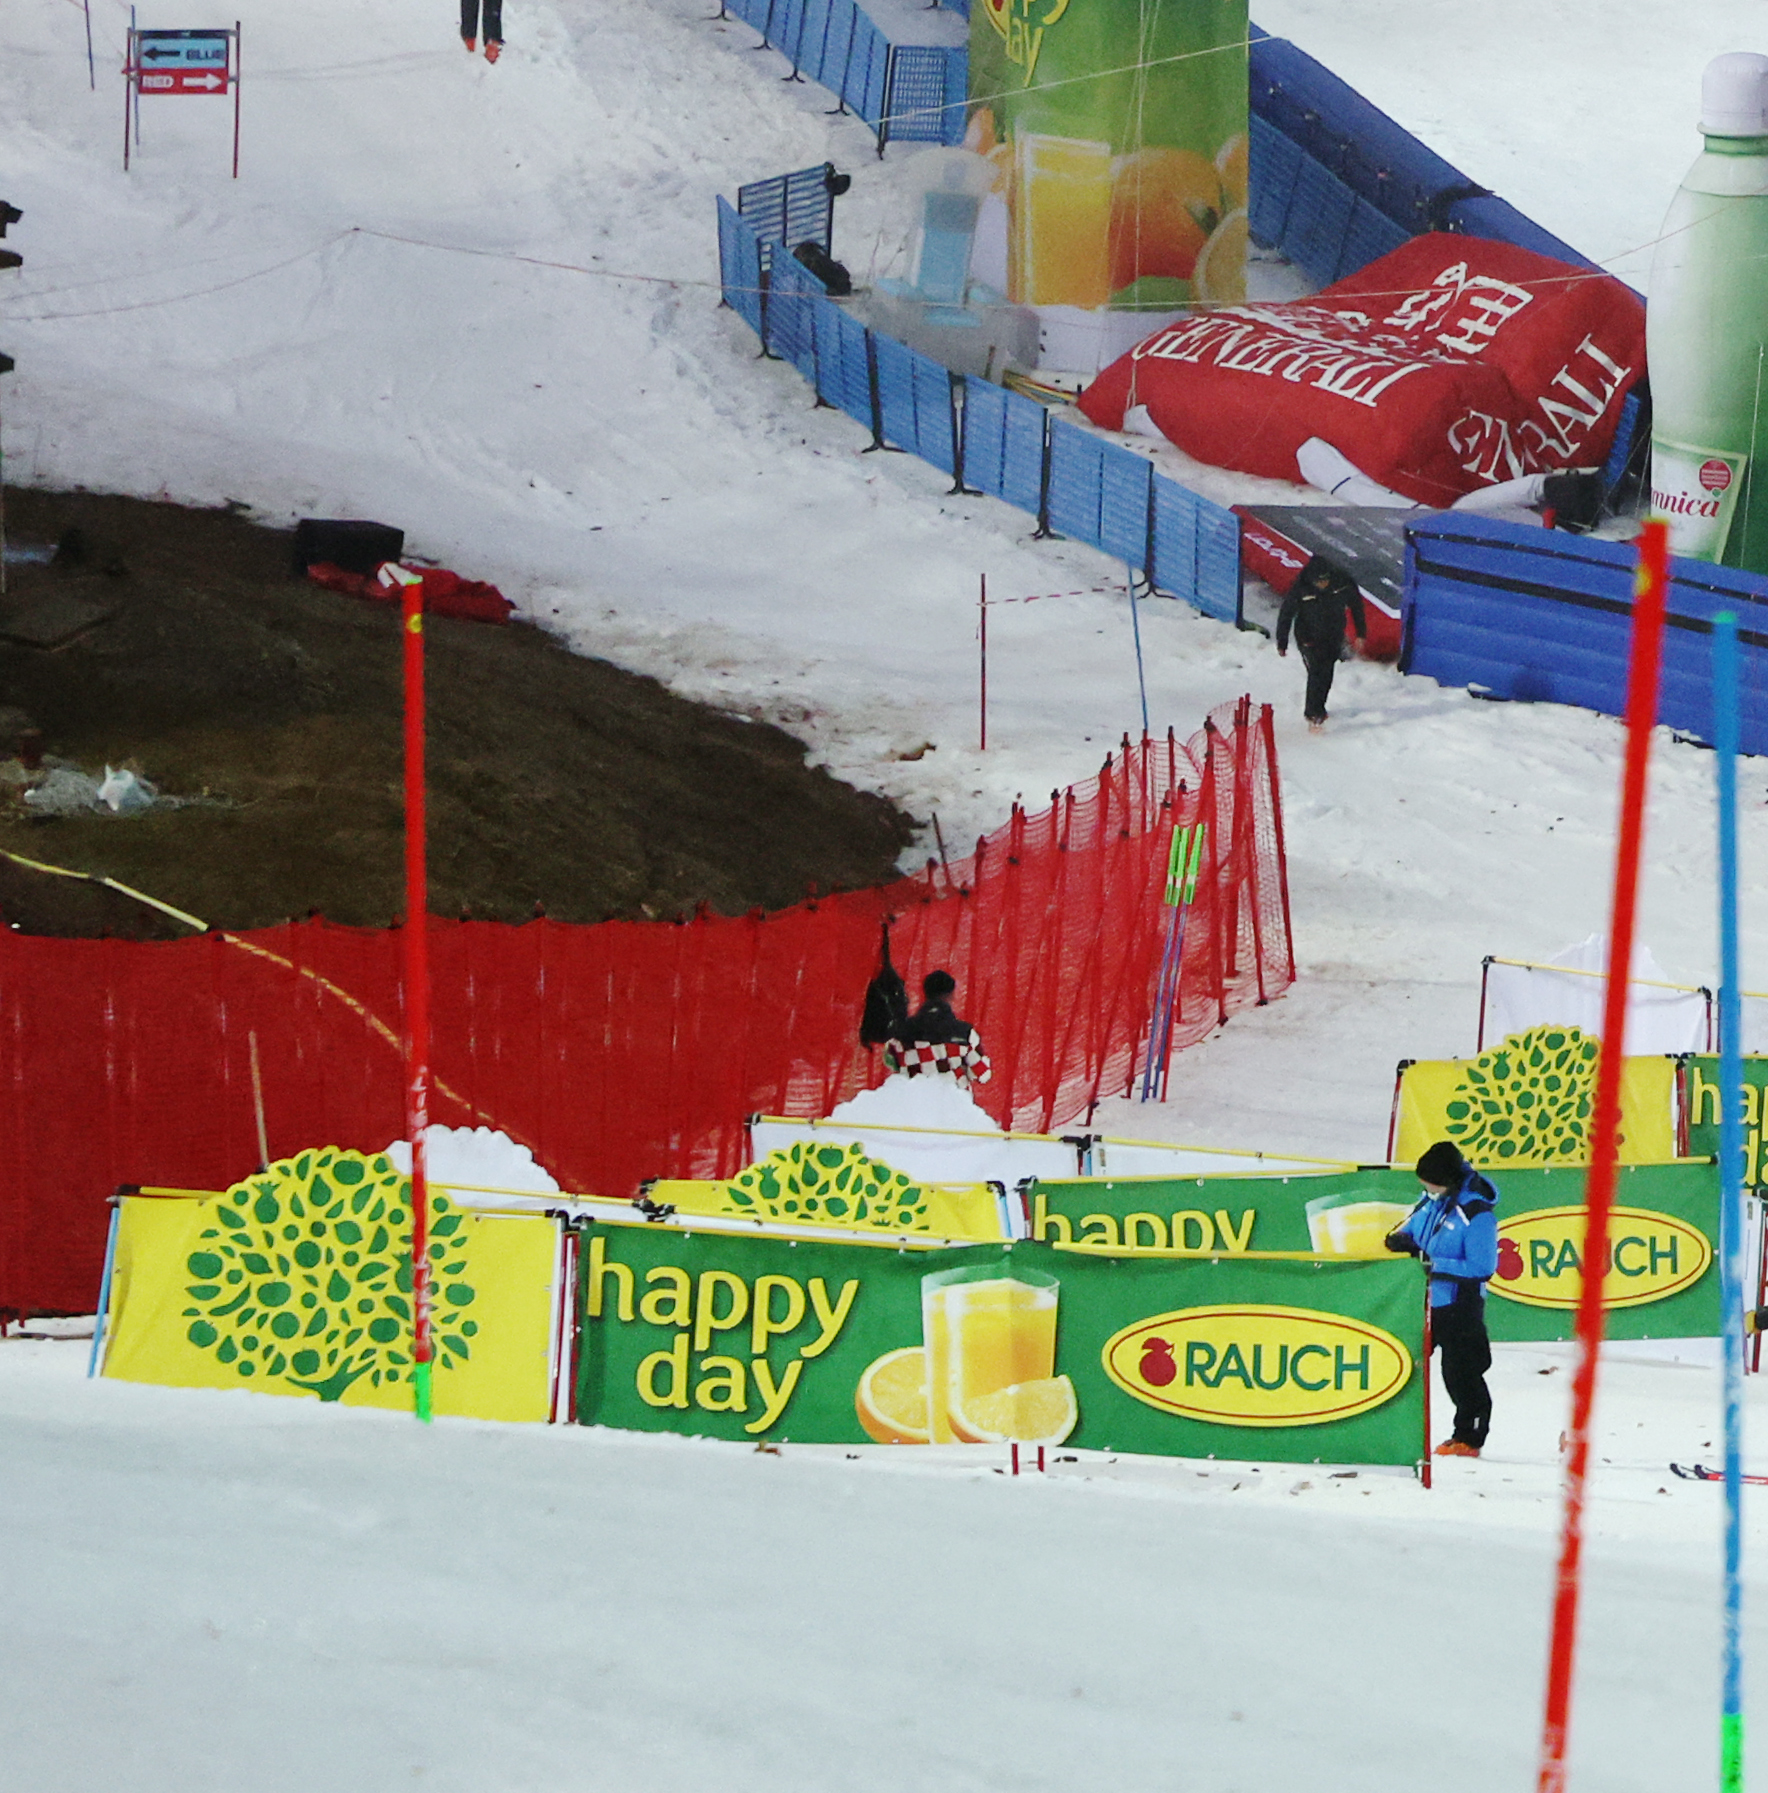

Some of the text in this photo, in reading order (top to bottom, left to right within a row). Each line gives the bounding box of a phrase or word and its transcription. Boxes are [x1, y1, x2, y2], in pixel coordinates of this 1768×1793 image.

[1033, 1193, 1256, 1253] happy
[590, 1235, 858, 1356] happy
[636, 1334, 803, 1436] day
[1181, 1342, 1371, 1393] RAUCH
